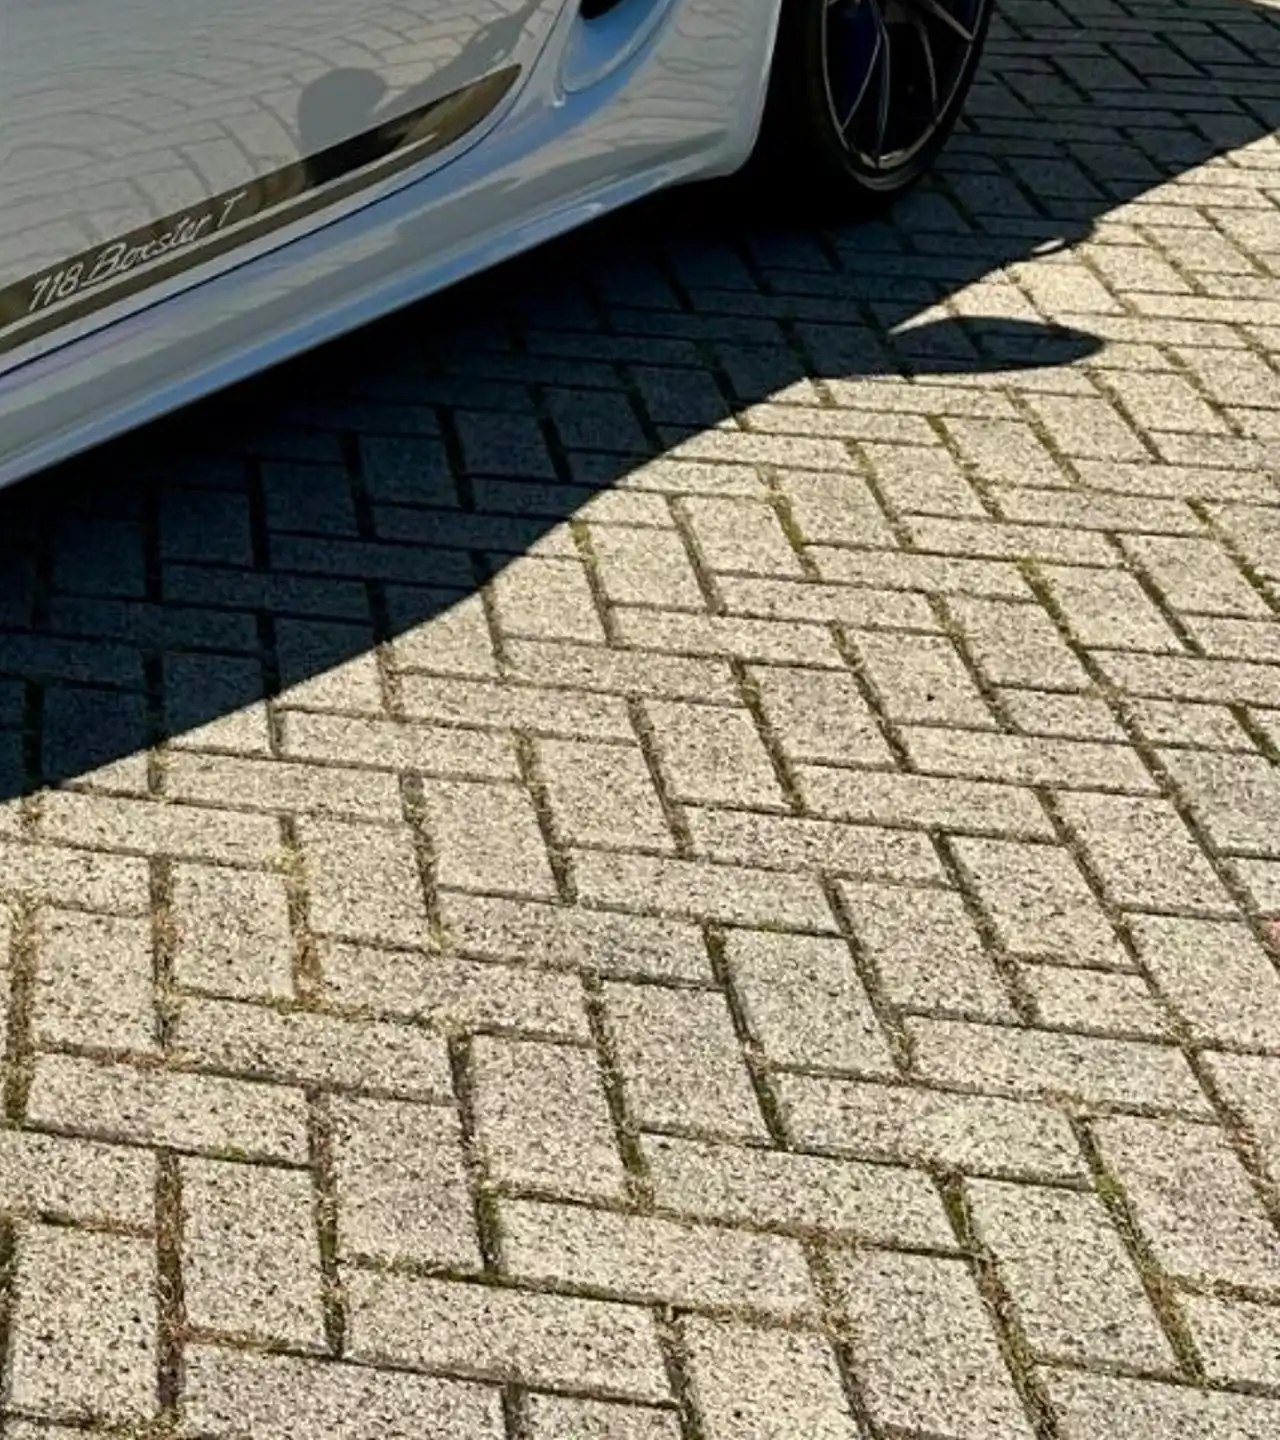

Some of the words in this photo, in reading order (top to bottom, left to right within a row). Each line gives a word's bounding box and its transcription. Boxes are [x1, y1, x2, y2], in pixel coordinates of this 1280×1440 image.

[29, 261, 85, 312] 718
[78, 214, 213, 289] Boxster
[217, 190, 248, 230] T
